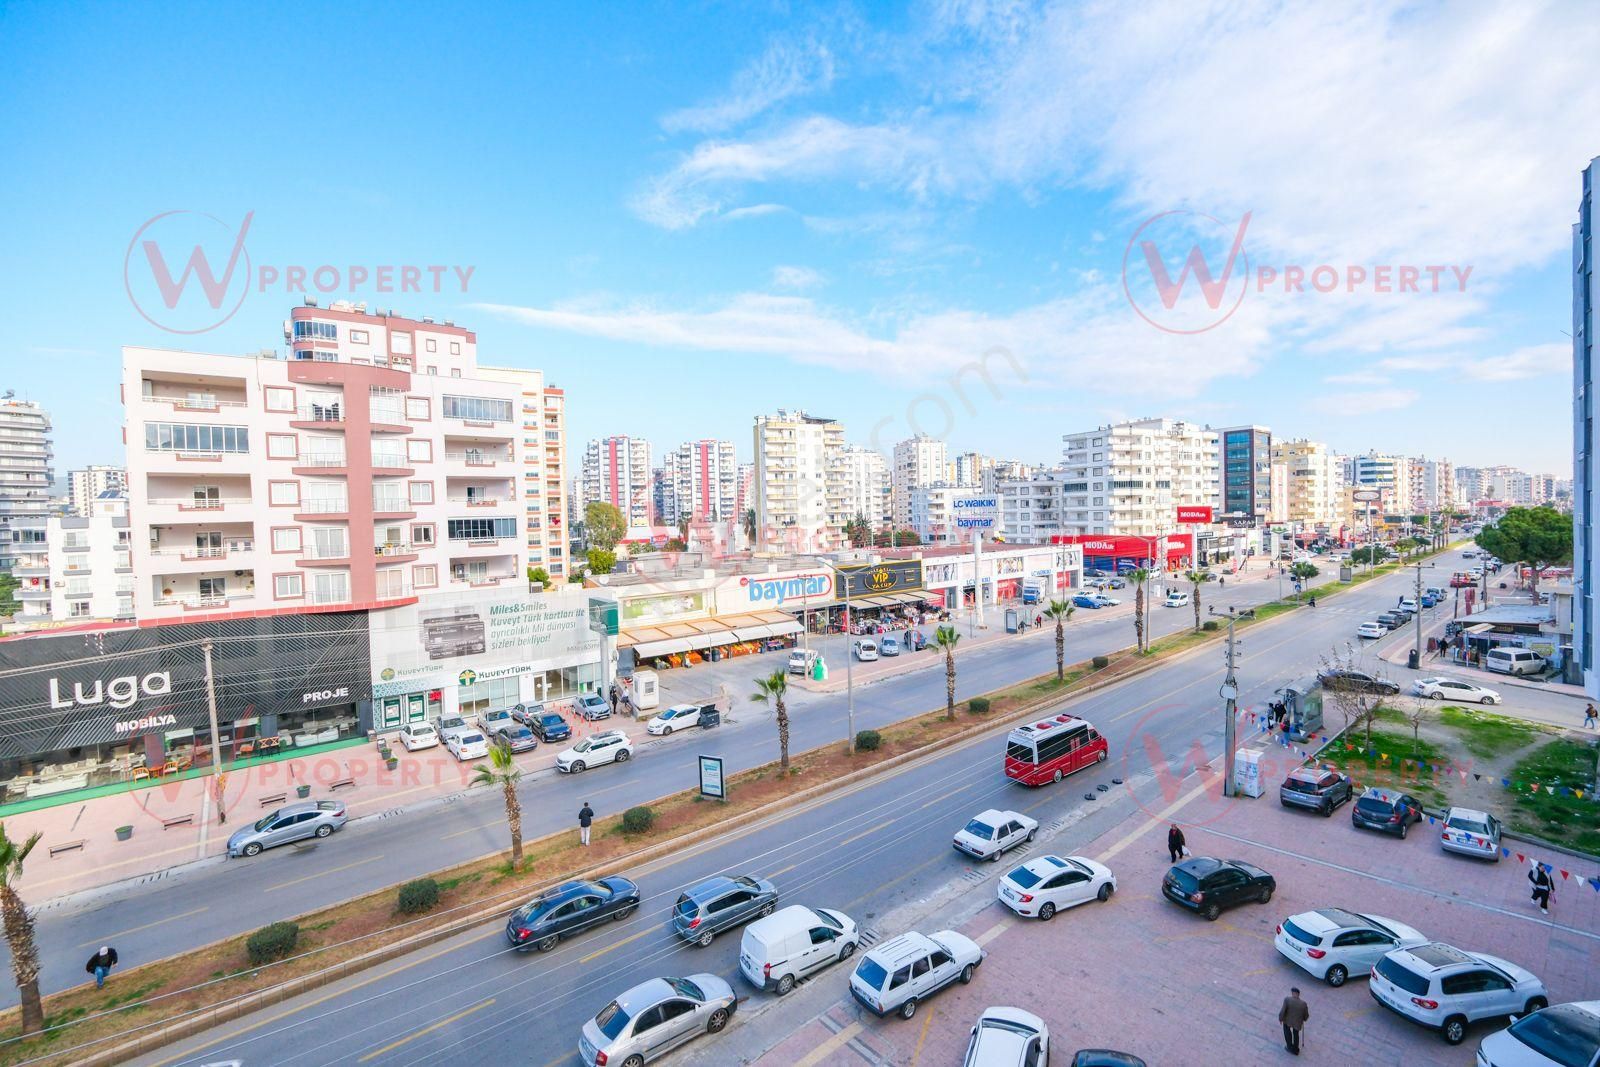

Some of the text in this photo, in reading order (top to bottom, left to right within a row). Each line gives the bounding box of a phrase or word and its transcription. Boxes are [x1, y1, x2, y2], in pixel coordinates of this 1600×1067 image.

[957, 517, 993, 530] baymar
[750, 575, 826, 605] baymar
[490, 601, 548, 616] Miles&Smiles
[491, 616, 521, 628] Kuveyt
[50, 670, 172, 709] Luga
[303, 687, 349, 703] PROJE
[116, 714, 177, 733] MOBİLYA
